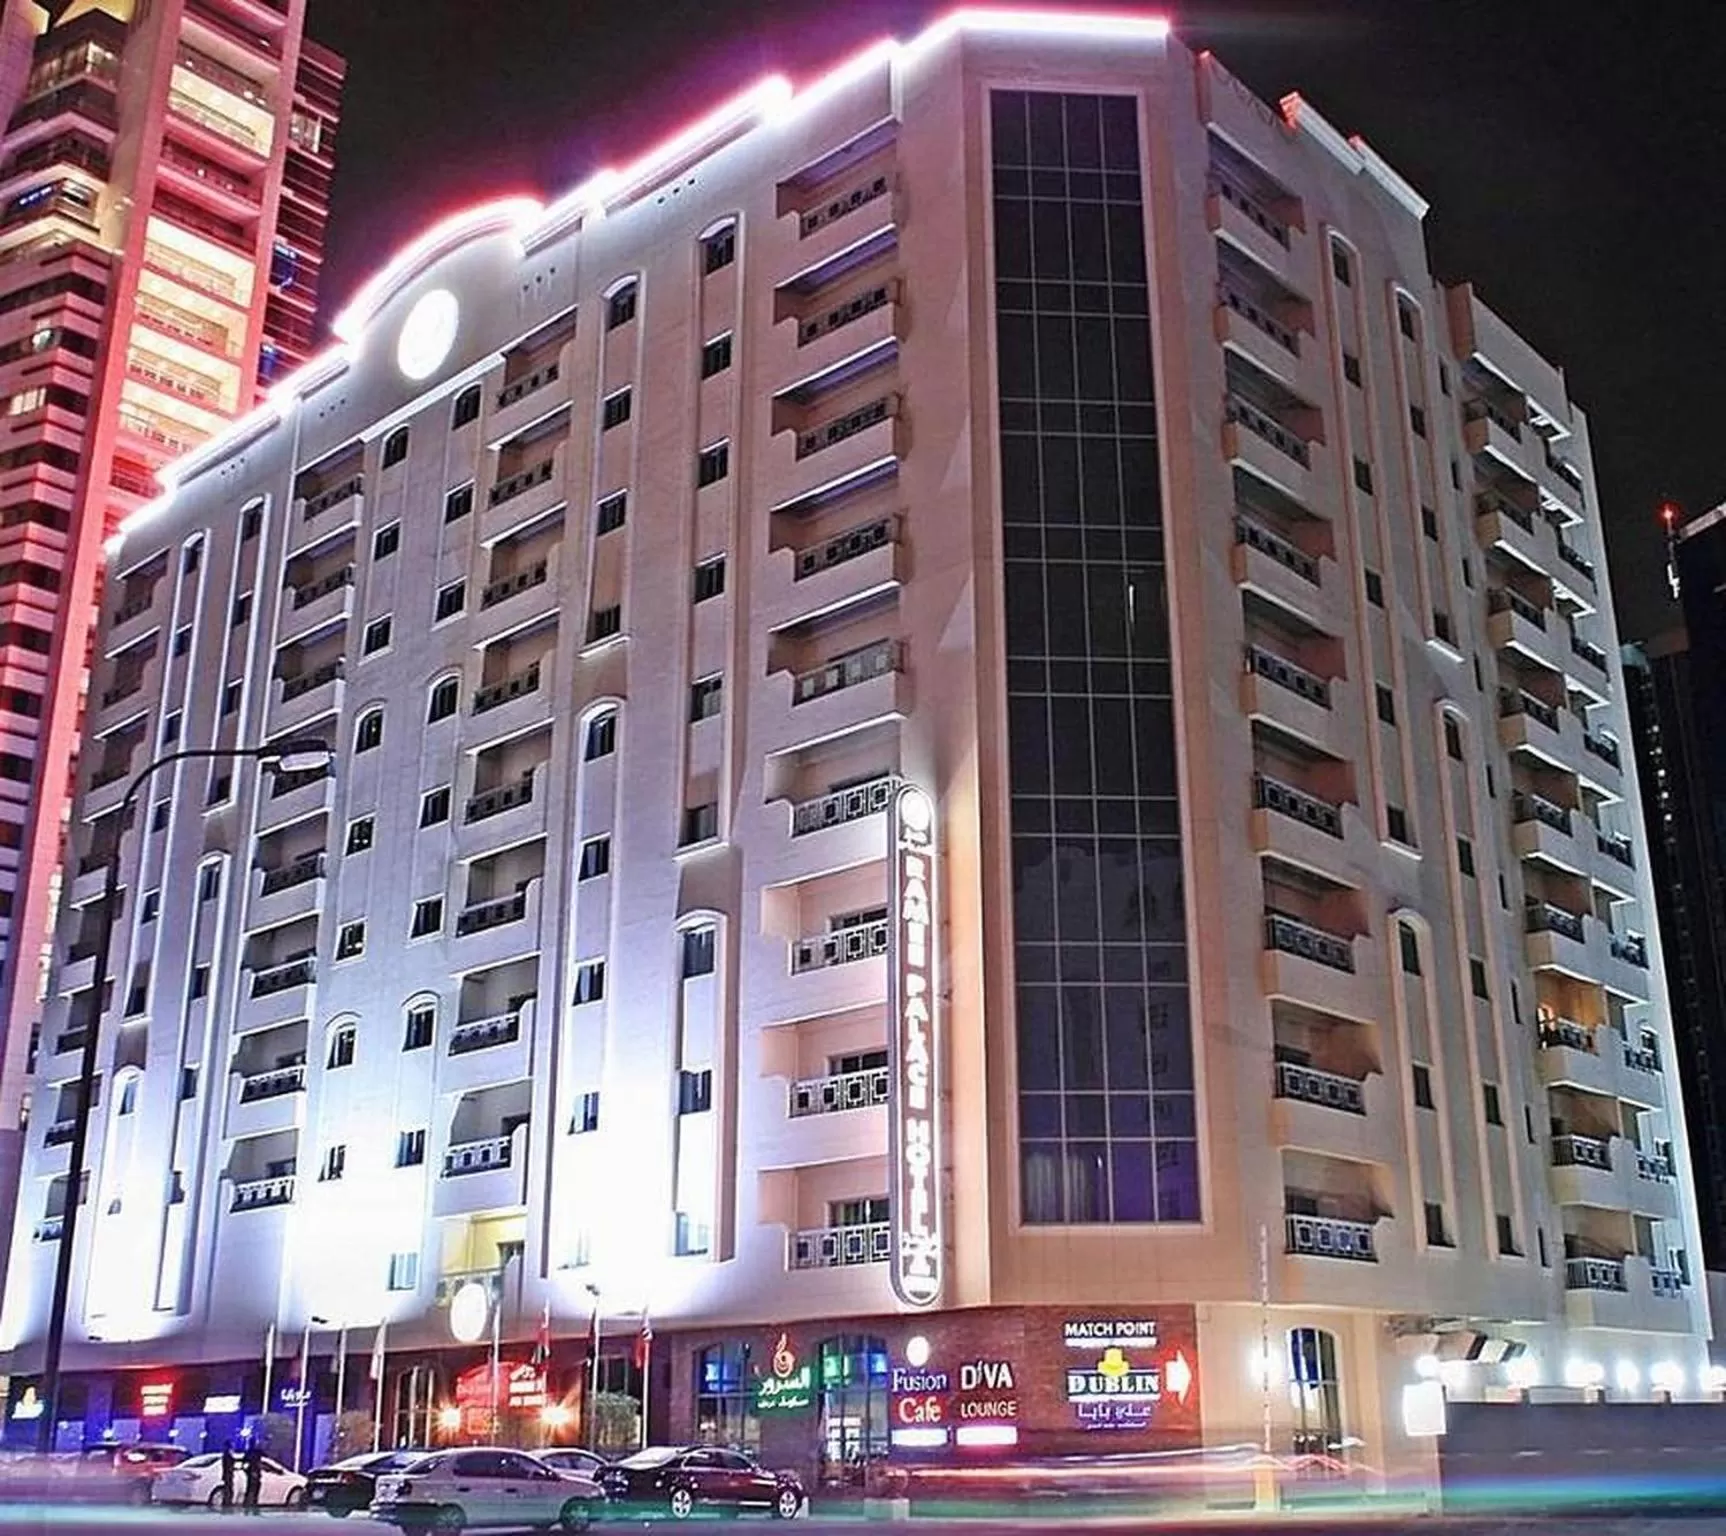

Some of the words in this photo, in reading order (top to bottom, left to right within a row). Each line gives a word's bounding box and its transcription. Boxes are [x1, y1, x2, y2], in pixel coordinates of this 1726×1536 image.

[904, 973, 929, 1110] PALACE
[905, 1118, 931, 1237] HOTEL
[1065, 1323, 1114, 1336] MATCH
[1116, 1322, 1156, 1336] POINT
[892, 1368, 947, 1392] Fusion
[1067, 1375, 1160, 1394] DUBLIN
[961, 1401, 1017, 1418] LOUNGE
